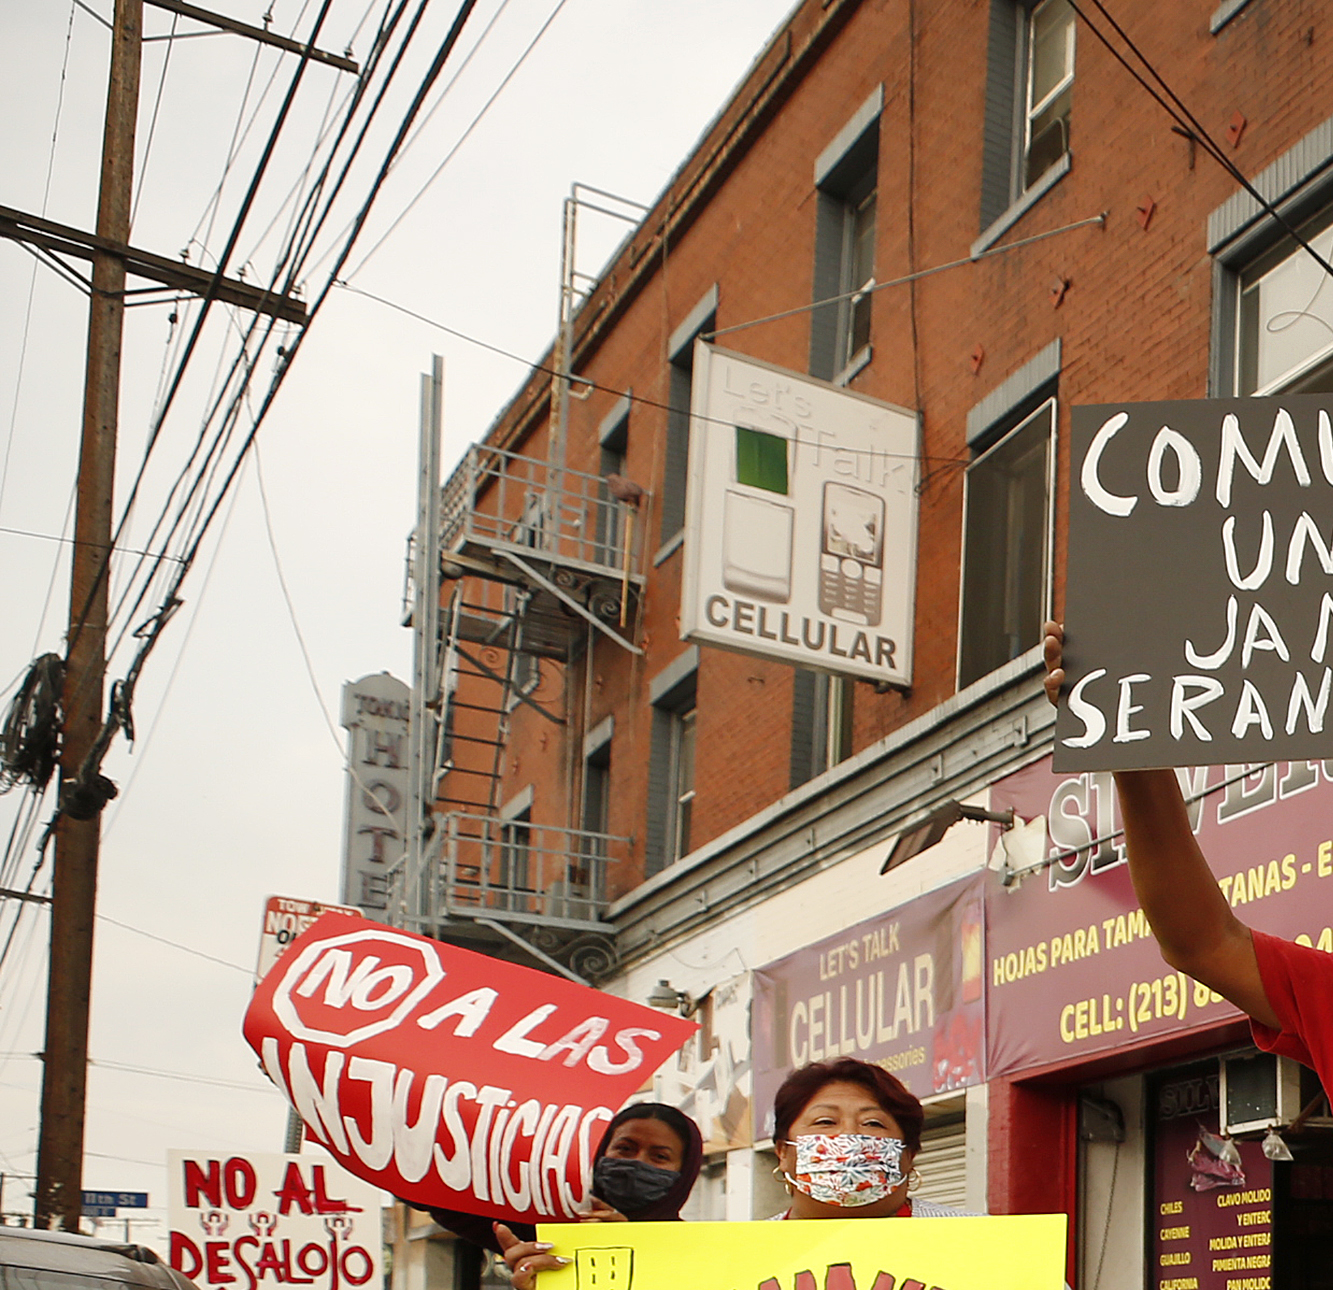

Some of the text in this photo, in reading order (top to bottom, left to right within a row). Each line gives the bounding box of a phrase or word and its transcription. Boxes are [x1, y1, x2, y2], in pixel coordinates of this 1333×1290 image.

[705, 594, 897, 671] CELLULAR
[354, 730, 409, 911] HOTE
[993, 946, 1047, 987] HOJAS
[1050, 925, 1100, 967] PARA
[1218, 853, 1297, 908] TANAS
[819, 921, 901, 982] LET'S TALK
[296, 948, 662, 1076] NO A LAS
[790, 953, 935, 1070] CELLULAR
[1059, 993, 1124, 1043] CELL:
[1128, 971, 1188, 1032] (213)
[184, 1156, 363, 1214] NO AL
[1160, 1201, 1183, 1215] CHILES
[1217, 1188, 1271, 1208] CLAVO MOLIDO
[1160, 1226, 1190, 1241] CAYENNE
[1209, 1236, 1238, 1251] MOLIDA
[1212, 1257, 1246, 1272] PIMIENTA
